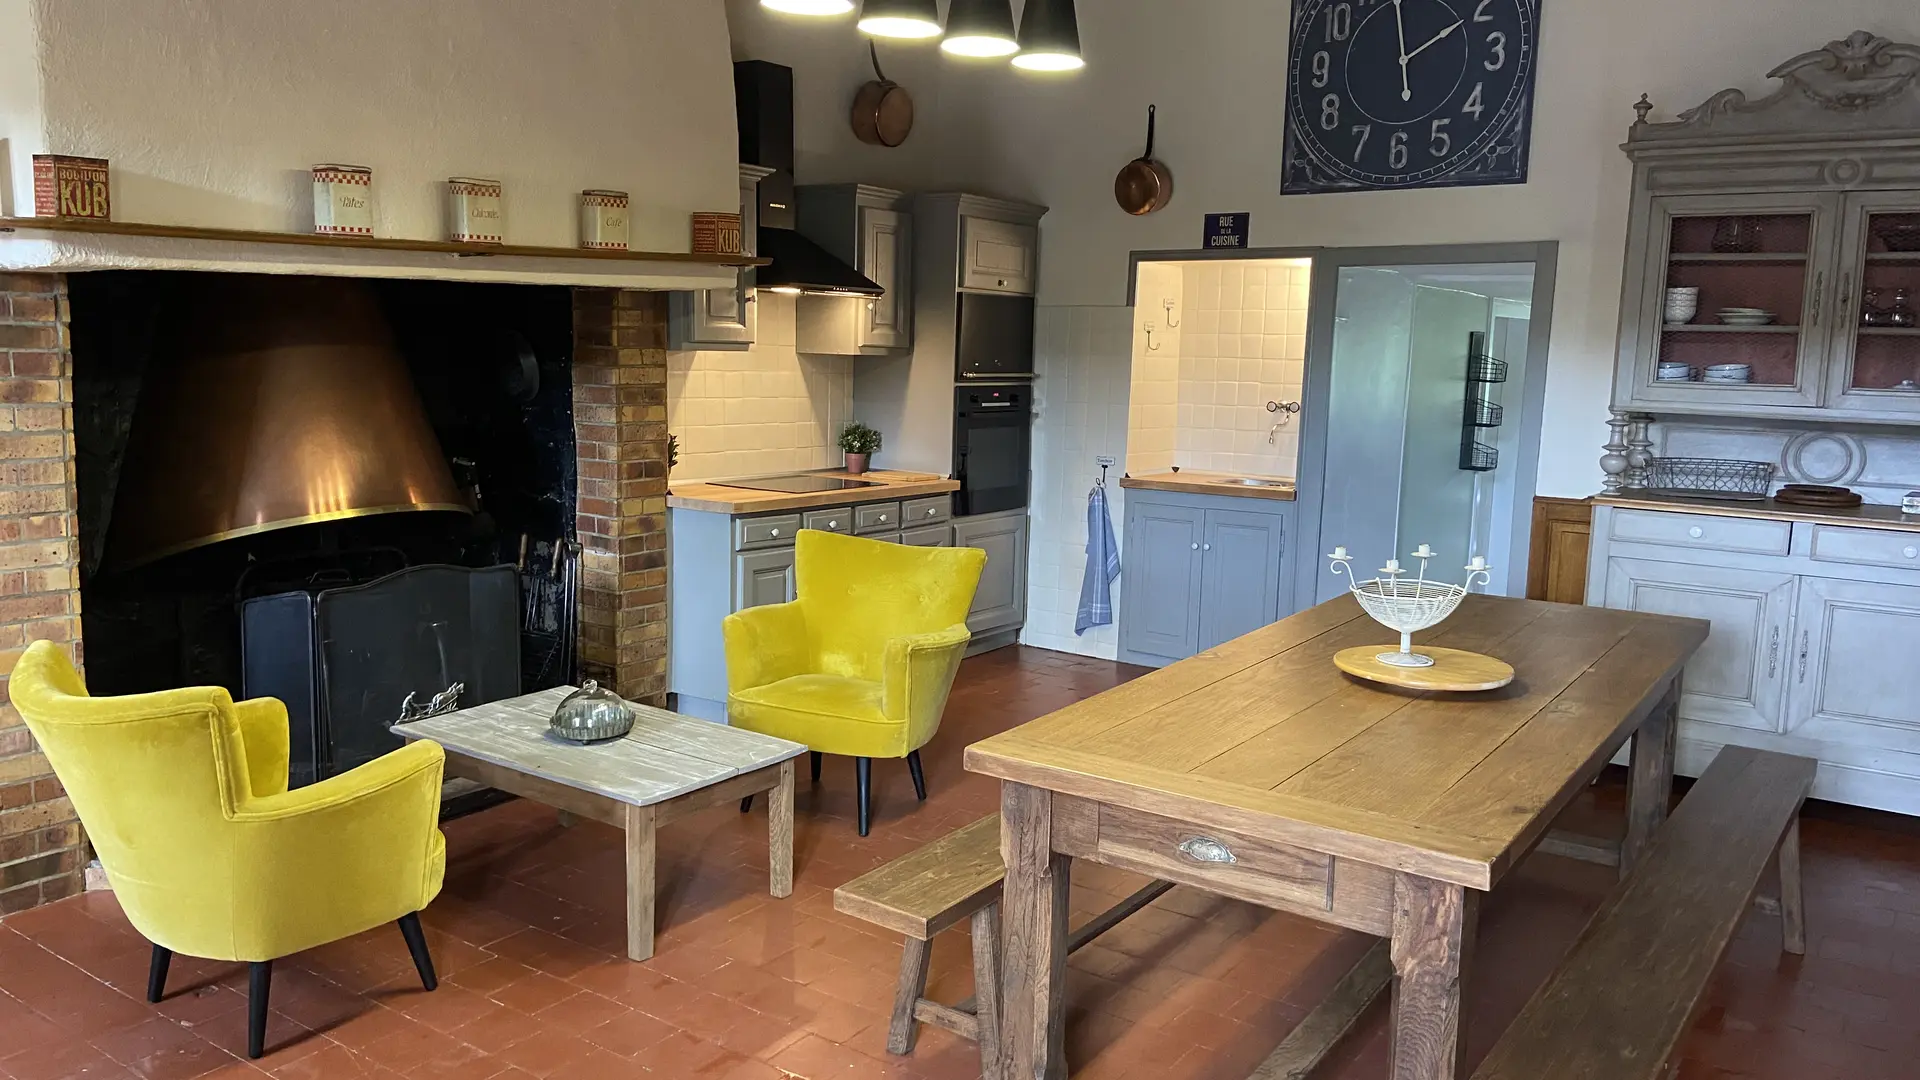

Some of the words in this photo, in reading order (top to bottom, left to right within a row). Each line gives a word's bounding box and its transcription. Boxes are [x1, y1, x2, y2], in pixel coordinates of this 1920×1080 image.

[1323, 3, 1351, 42] 10
[1311, 50, 1330, 88] 9
[1483, 31, 1507, 72] 3
[1320, 93, 1340, 130] 8
[1461, 82, 1485, 121] 4
[1351, 124, 1371, 162] 7
[1389, 131, 1408, 169] 6
[1429, 118, 1451, 157] 5
[60, 180, 107, 216] KUB
[1219, 215, 1234, 227] RUE
[718, 229, 740, 252] KUB
[1211, 235, 1240, 246] CUISINE
